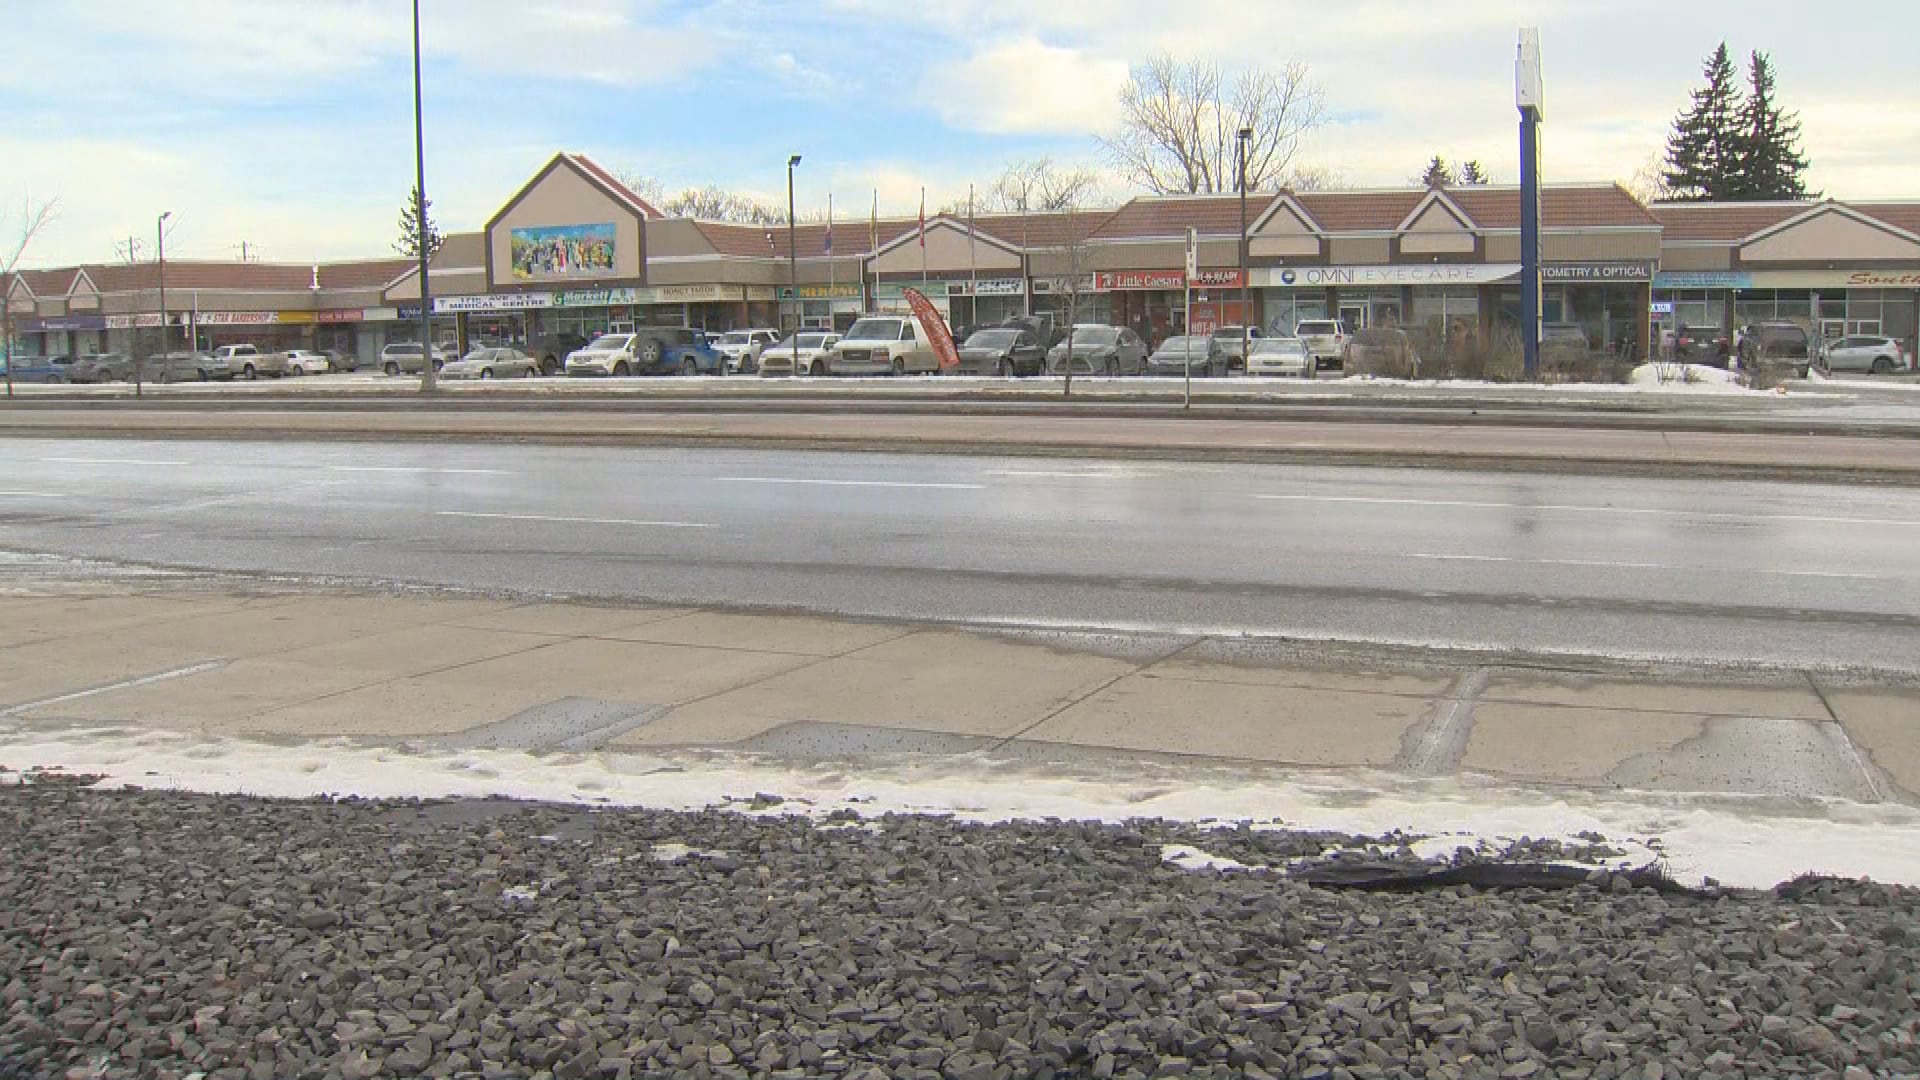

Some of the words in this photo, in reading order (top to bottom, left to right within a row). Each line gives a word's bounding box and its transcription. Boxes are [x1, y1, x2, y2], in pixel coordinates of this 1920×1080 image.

[1307, 269, 1354, 283] OMNI
[1366, 267, 1476, 280] EYECARE
[1541, 267, 1591, 277] TOMETRY
[1593, 267, 1600, 277] &
[1602, 266, 1648, 277] OPTICAL
[1117, 275, 1143, 287] Little
[1144, 273, 1182, 286] Caesars
[502, 299, 545, 307] CENTRE
